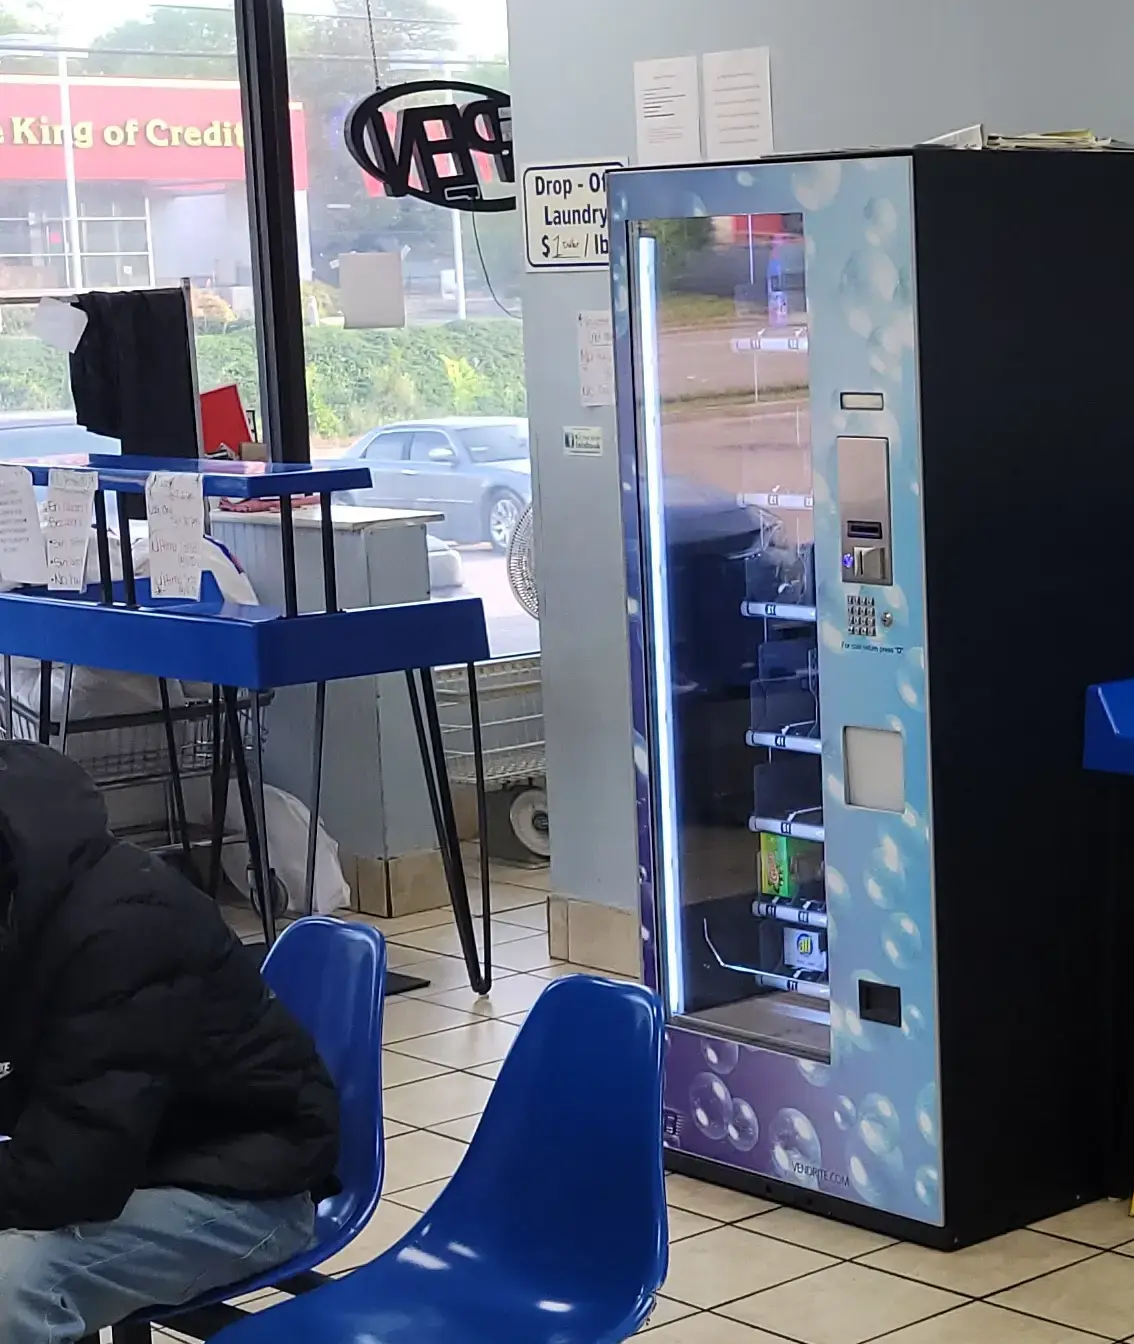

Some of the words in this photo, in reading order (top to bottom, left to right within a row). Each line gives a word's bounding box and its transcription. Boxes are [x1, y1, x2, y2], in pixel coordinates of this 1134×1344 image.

[103, 118, 139, 146] of
[535, 175, 573, 200] Drop
[544, 204, 607, 229] Laundry
[799, 936, 811, 954] all
